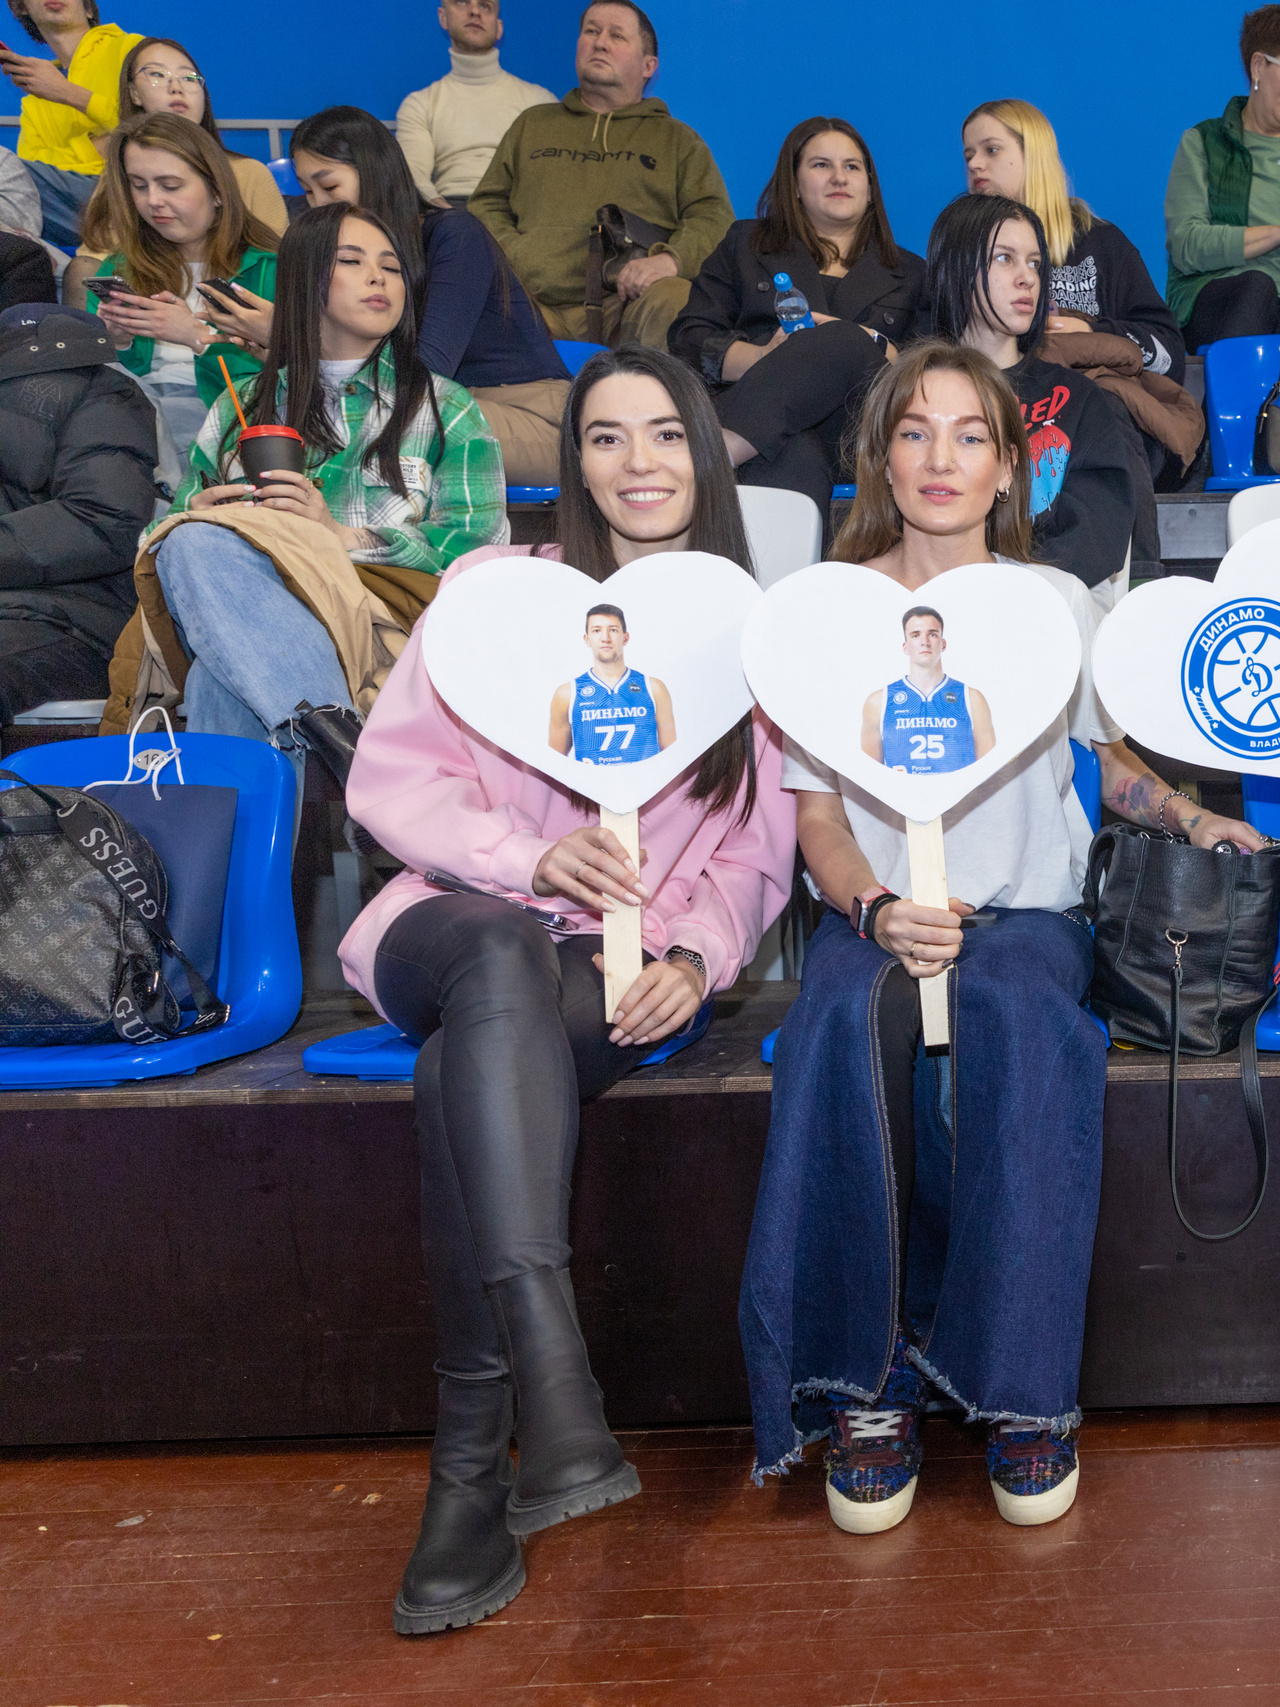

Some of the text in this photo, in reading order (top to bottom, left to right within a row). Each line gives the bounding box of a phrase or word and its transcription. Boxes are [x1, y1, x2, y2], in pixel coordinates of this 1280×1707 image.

[529, 147, 636, 163] carhartt
[1199, 607, 1266, 652] ДИНАМО
[581, 706, 648, 722] ДИНАМО
[895, 717, 958, 730] ДИНАМО
[594, 723, 636, 751] 77
[908, 734, 946, 760] 25
[78, 827, 159, 920] GUESS
